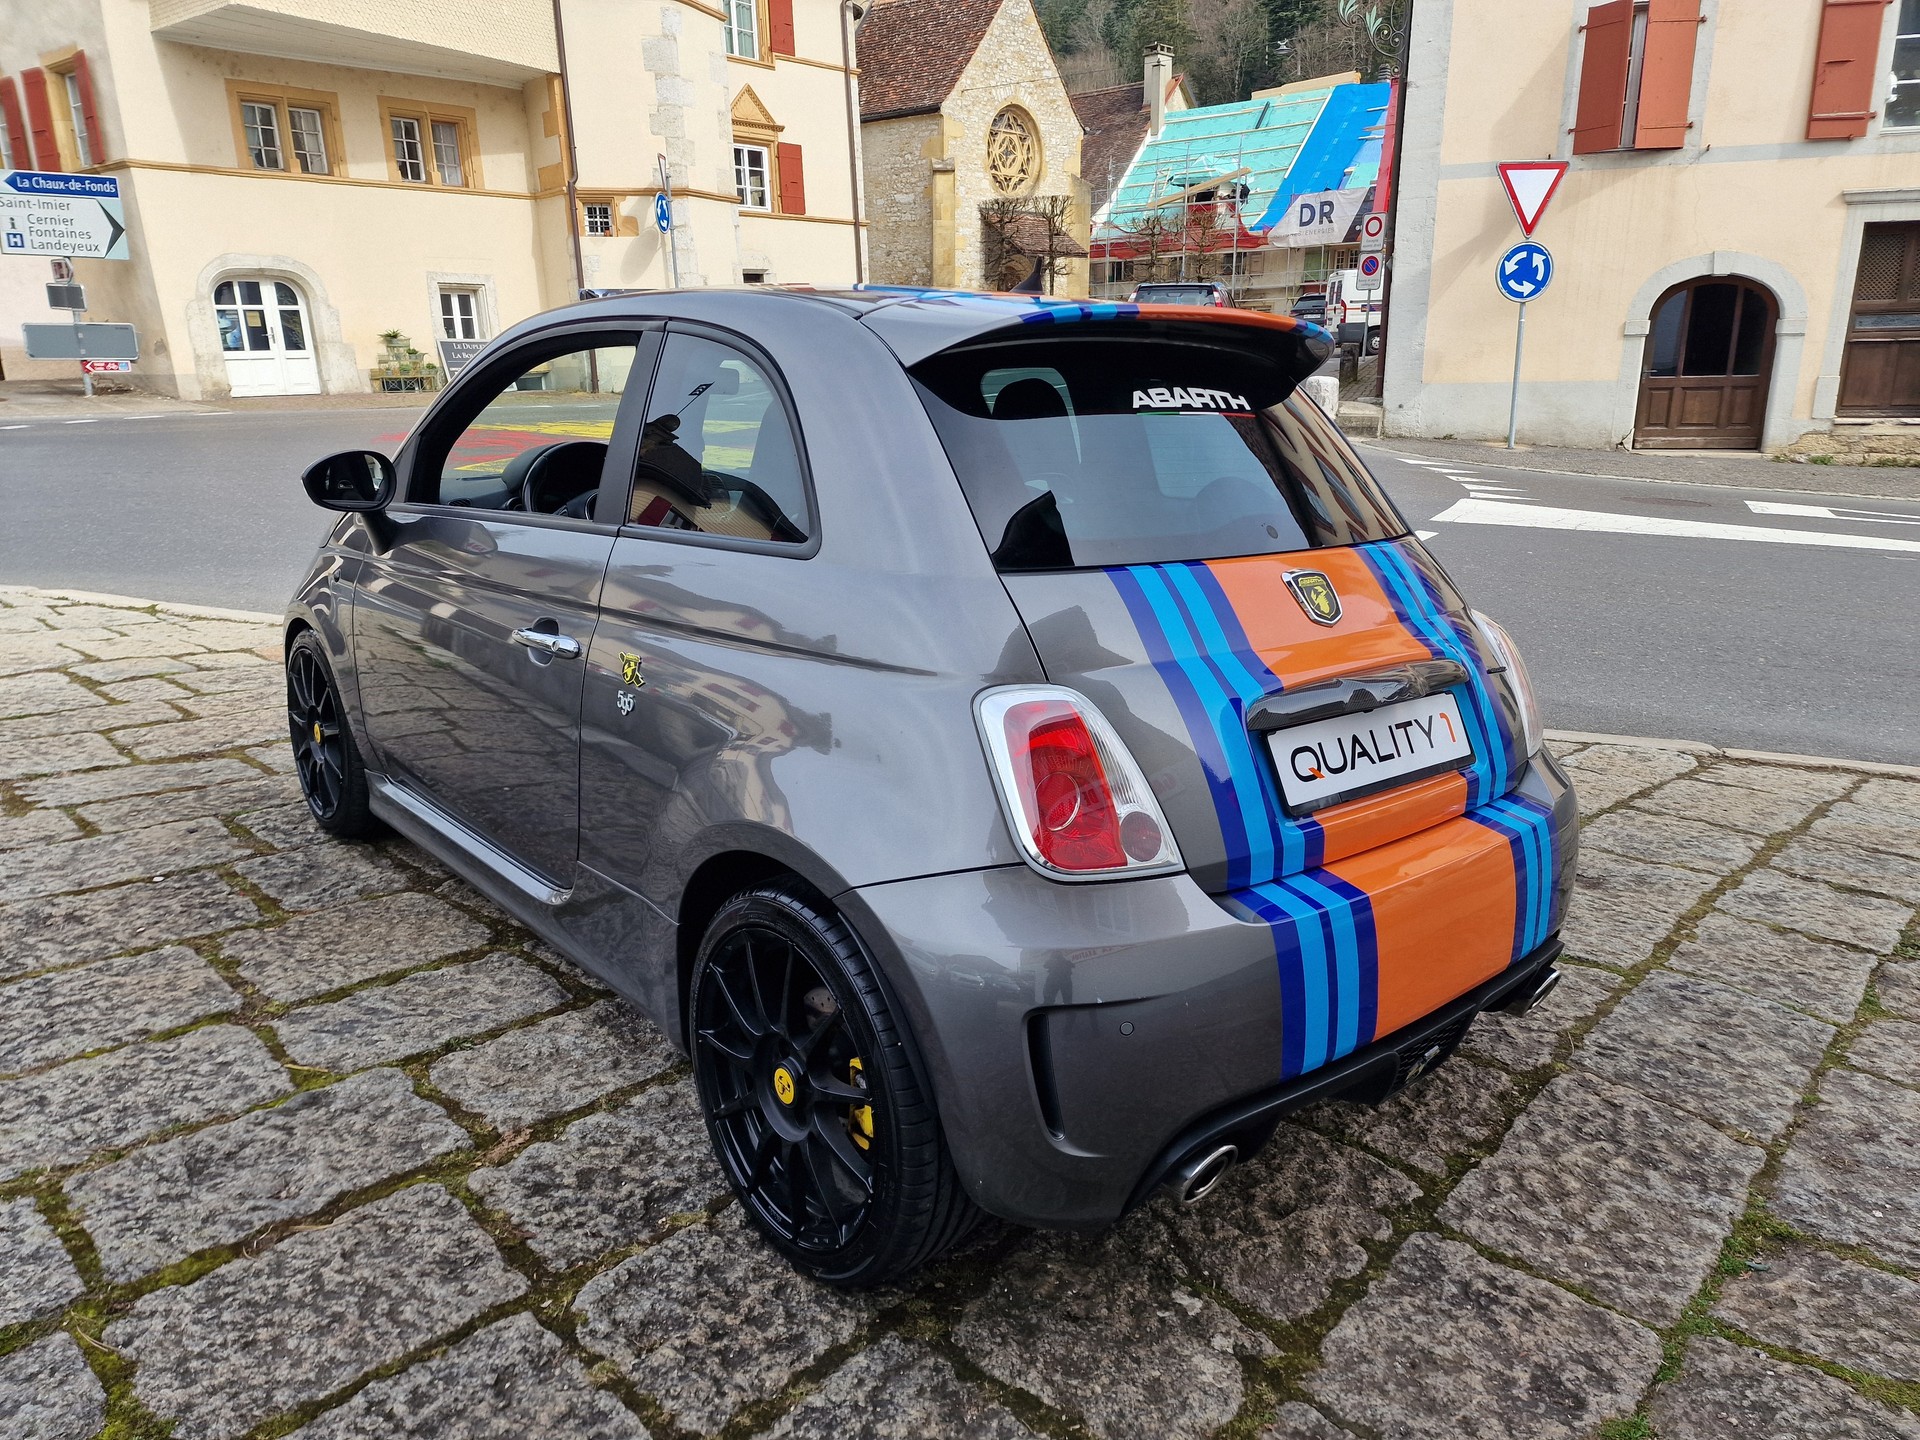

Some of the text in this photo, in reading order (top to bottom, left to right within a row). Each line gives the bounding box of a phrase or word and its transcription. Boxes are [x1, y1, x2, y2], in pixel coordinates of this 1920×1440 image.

[17, 176, 116, 193] La Chaux-de-Fonds
[0, 197, 71, 211] Saint-Imier
[27, 214, 74, 226] Cernier
[1299, 200, 1335, 227] DR
[28, 226, 92, 240] Fontaines
[30, 239, 101, 254] Landeyeux
[1132, 387, 1251, 410] ABARTH
